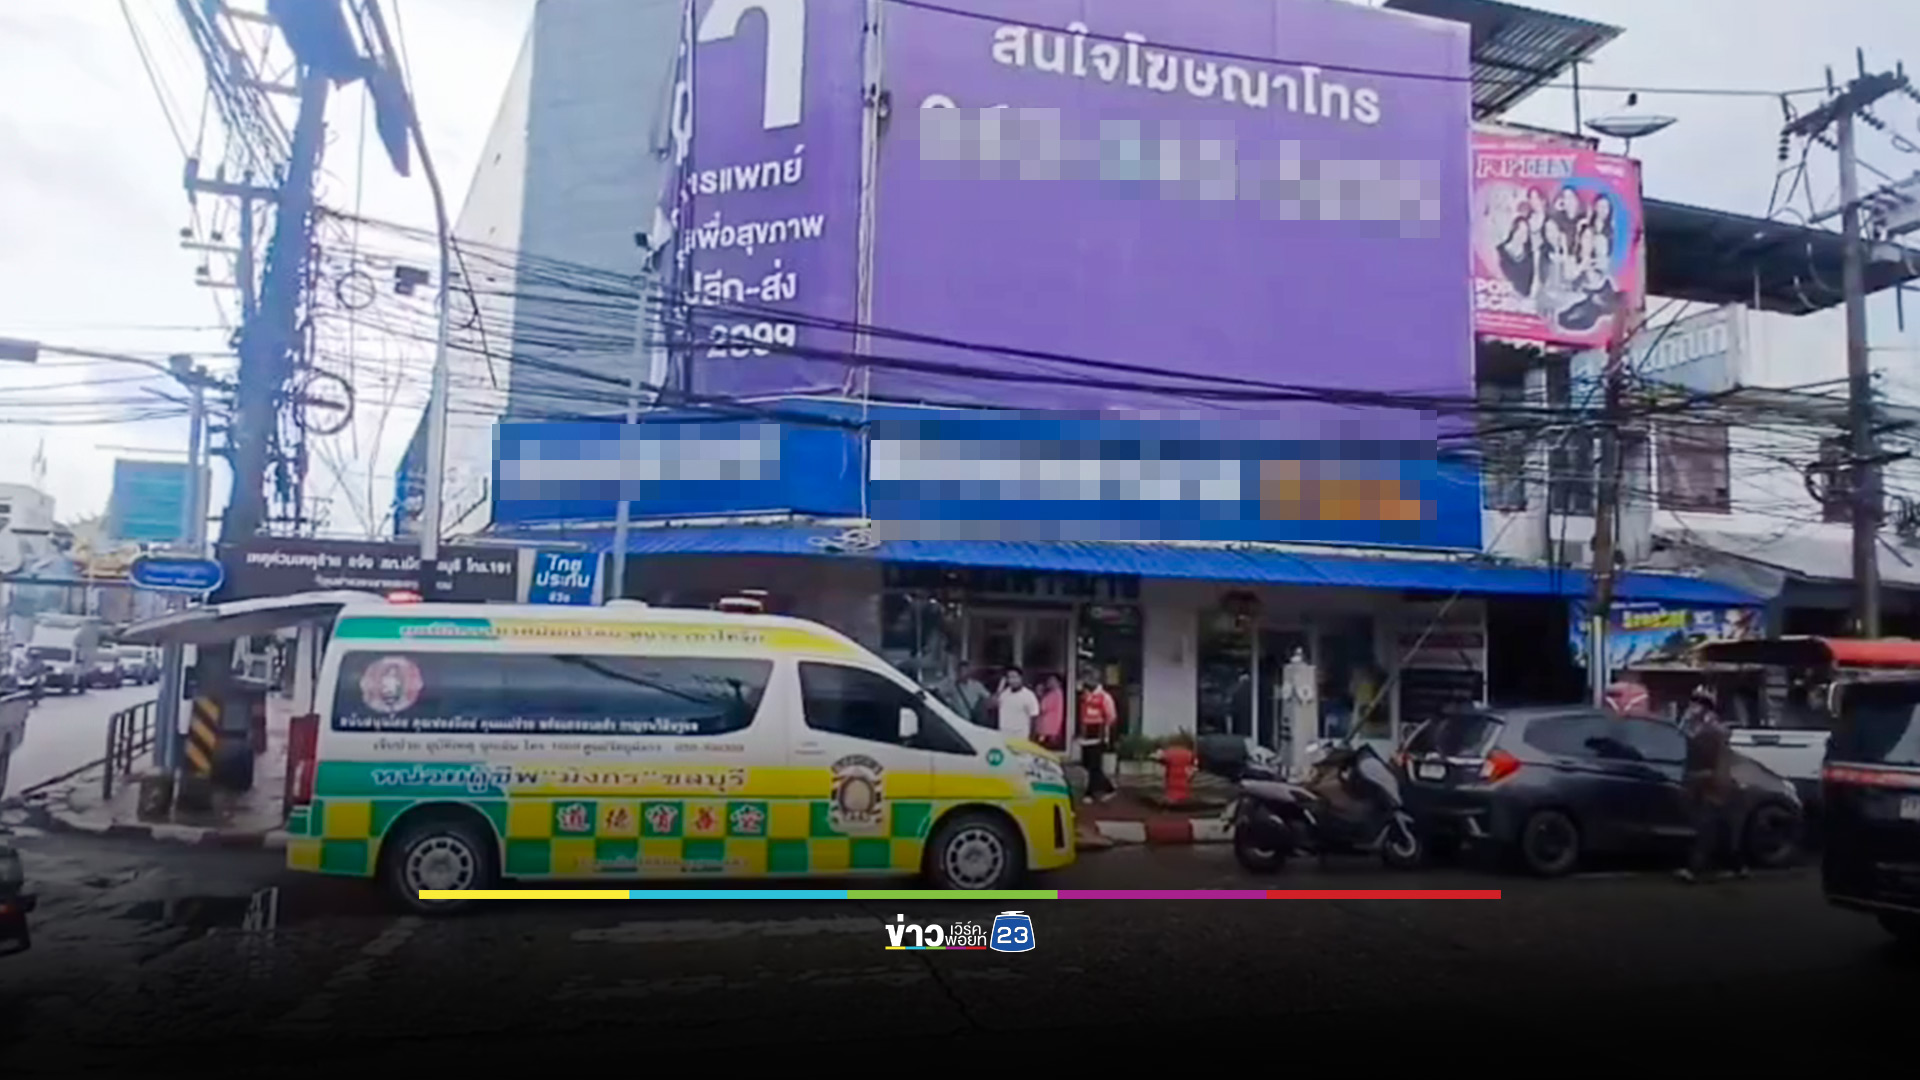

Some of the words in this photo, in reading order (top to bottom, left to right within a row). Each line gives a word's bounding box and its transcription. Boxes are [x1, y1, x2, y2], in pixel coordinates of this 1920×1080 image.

[991, 22, 1382, 126] สนใจโฆษณาโทร
